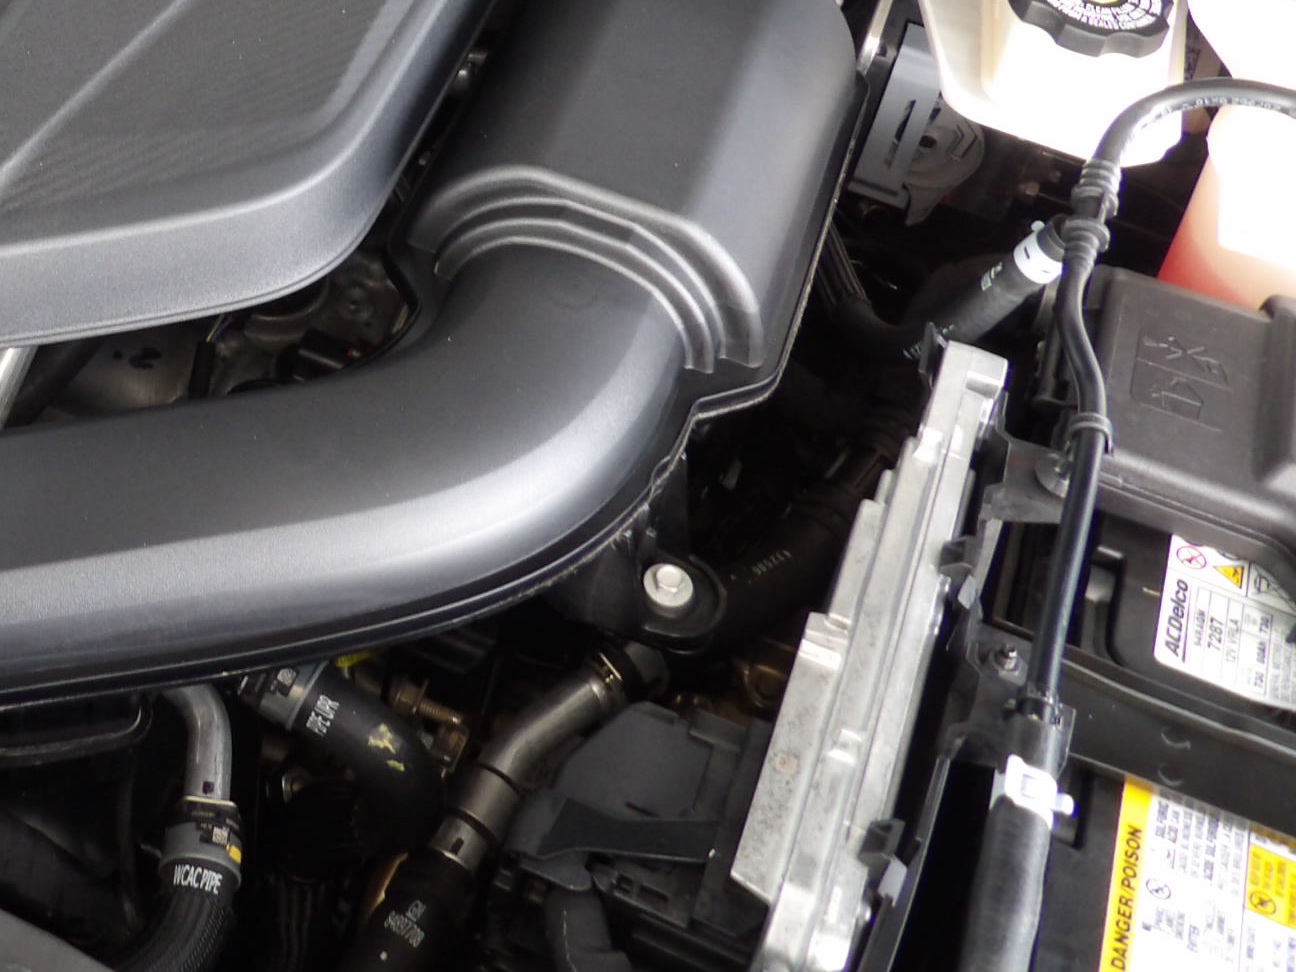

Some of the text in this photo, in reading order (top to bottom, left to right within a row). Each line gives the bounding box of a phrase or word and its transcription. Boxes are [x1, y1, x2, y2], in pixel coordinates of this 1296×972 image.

[1165, 579, 1189, 657] ACDelco
[1208, 617, 1224, 651] 7287
[200, 867, 223, 895] PIPE
[1111, 825, 1142, 971] DANGER/POISON
